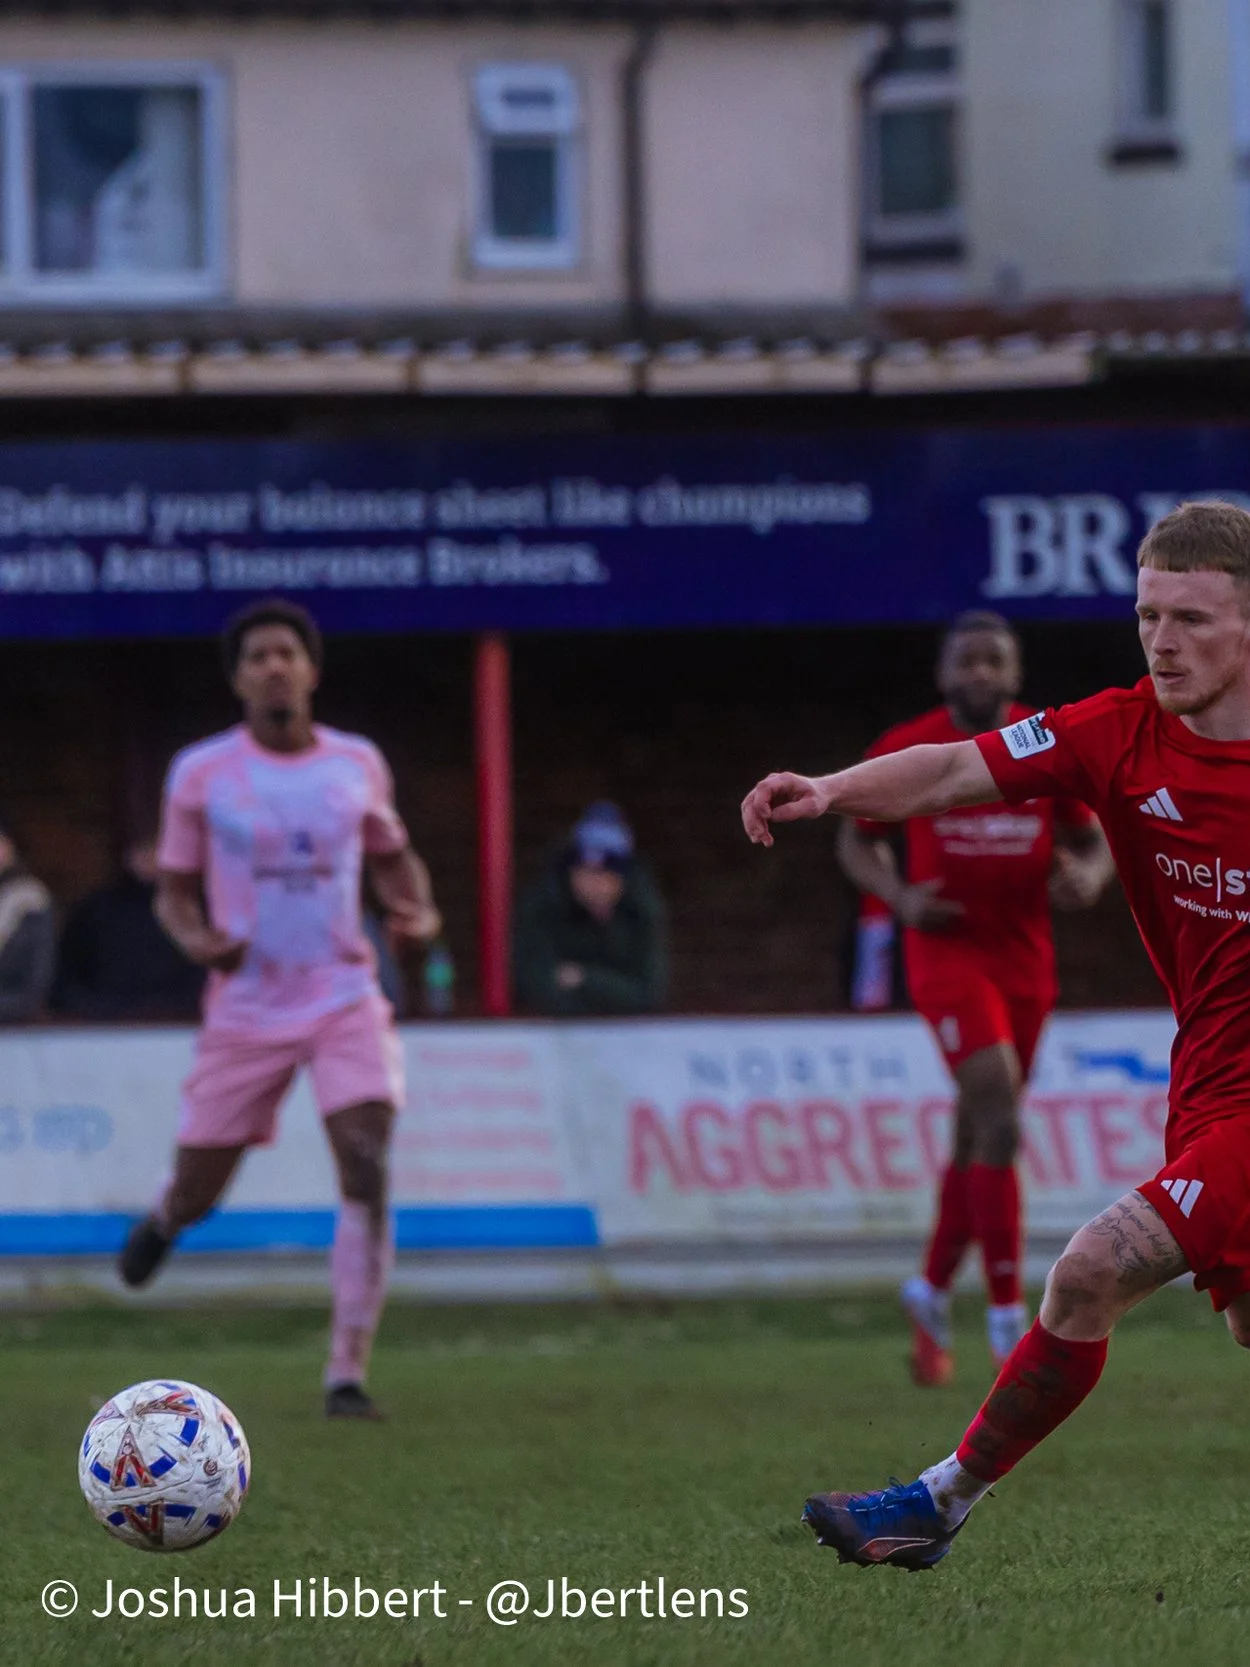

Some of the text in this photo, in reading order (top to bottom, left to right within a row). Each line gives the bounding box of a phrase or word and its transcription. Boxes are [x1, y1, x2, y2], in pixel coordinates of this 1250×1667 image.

[151, 492, 252, 545] your
[257, 481, 427, 532] balance
[433, 480, 545, 528] sheet
[551, 477, 631, 527] like
[636, 475, 870, 533] champions
[209, 541, 423, 589] Insurance
[1174, 895, 1207, 918] working
[1209, 908, 1232, 920] with
[690, 1051, 908, 1089] NORTH
